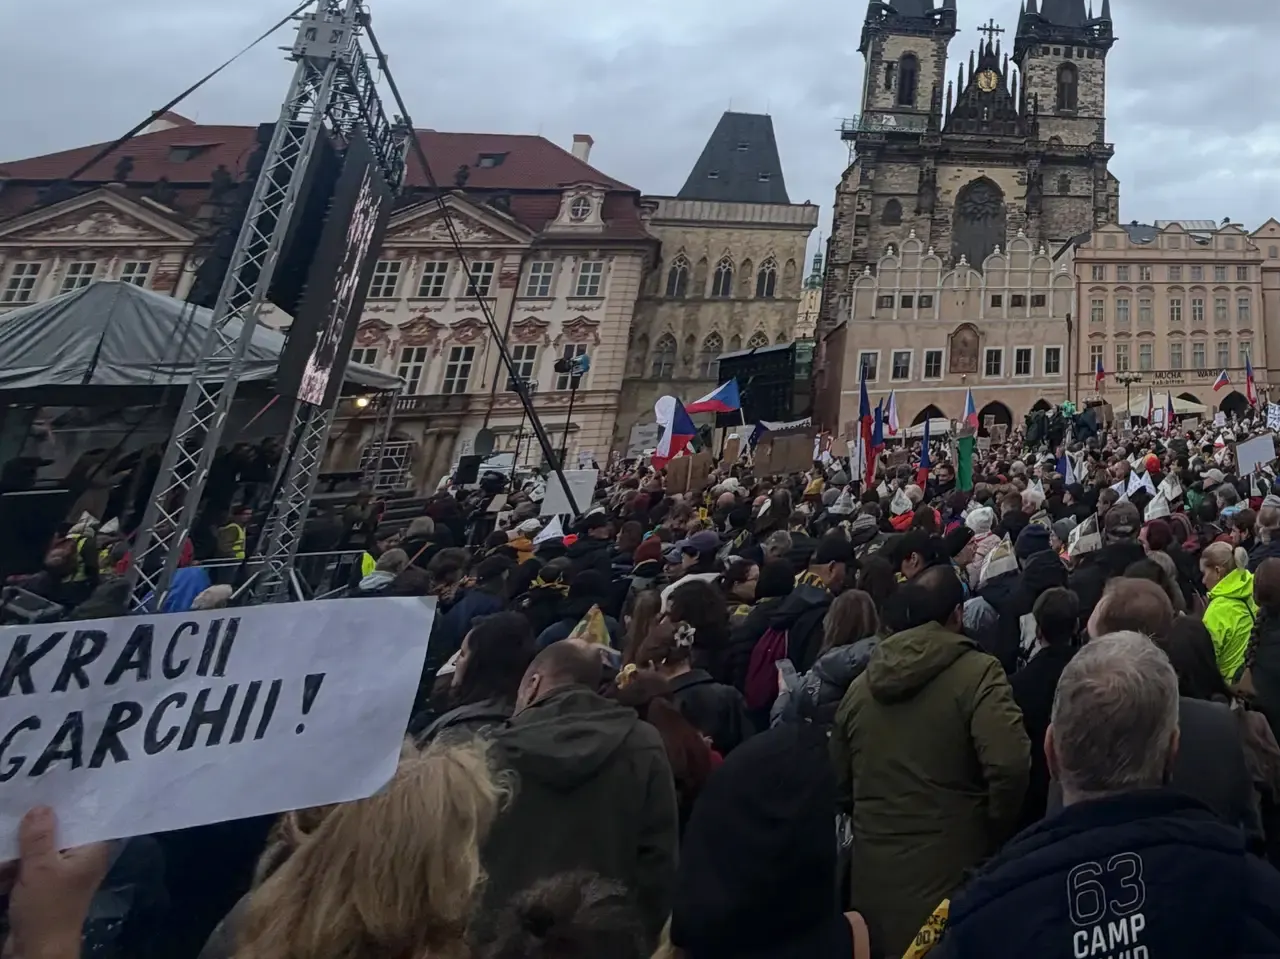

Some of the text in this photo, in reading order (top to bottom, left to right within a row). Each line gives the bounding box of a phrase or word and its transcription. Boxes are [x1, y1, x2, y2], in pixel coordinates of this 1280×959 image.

[1155, 371, 1182, 380] MUCHA
[1067, 851, 1146, 926] 63
[1073, 912, 1146, 959] CAMP
